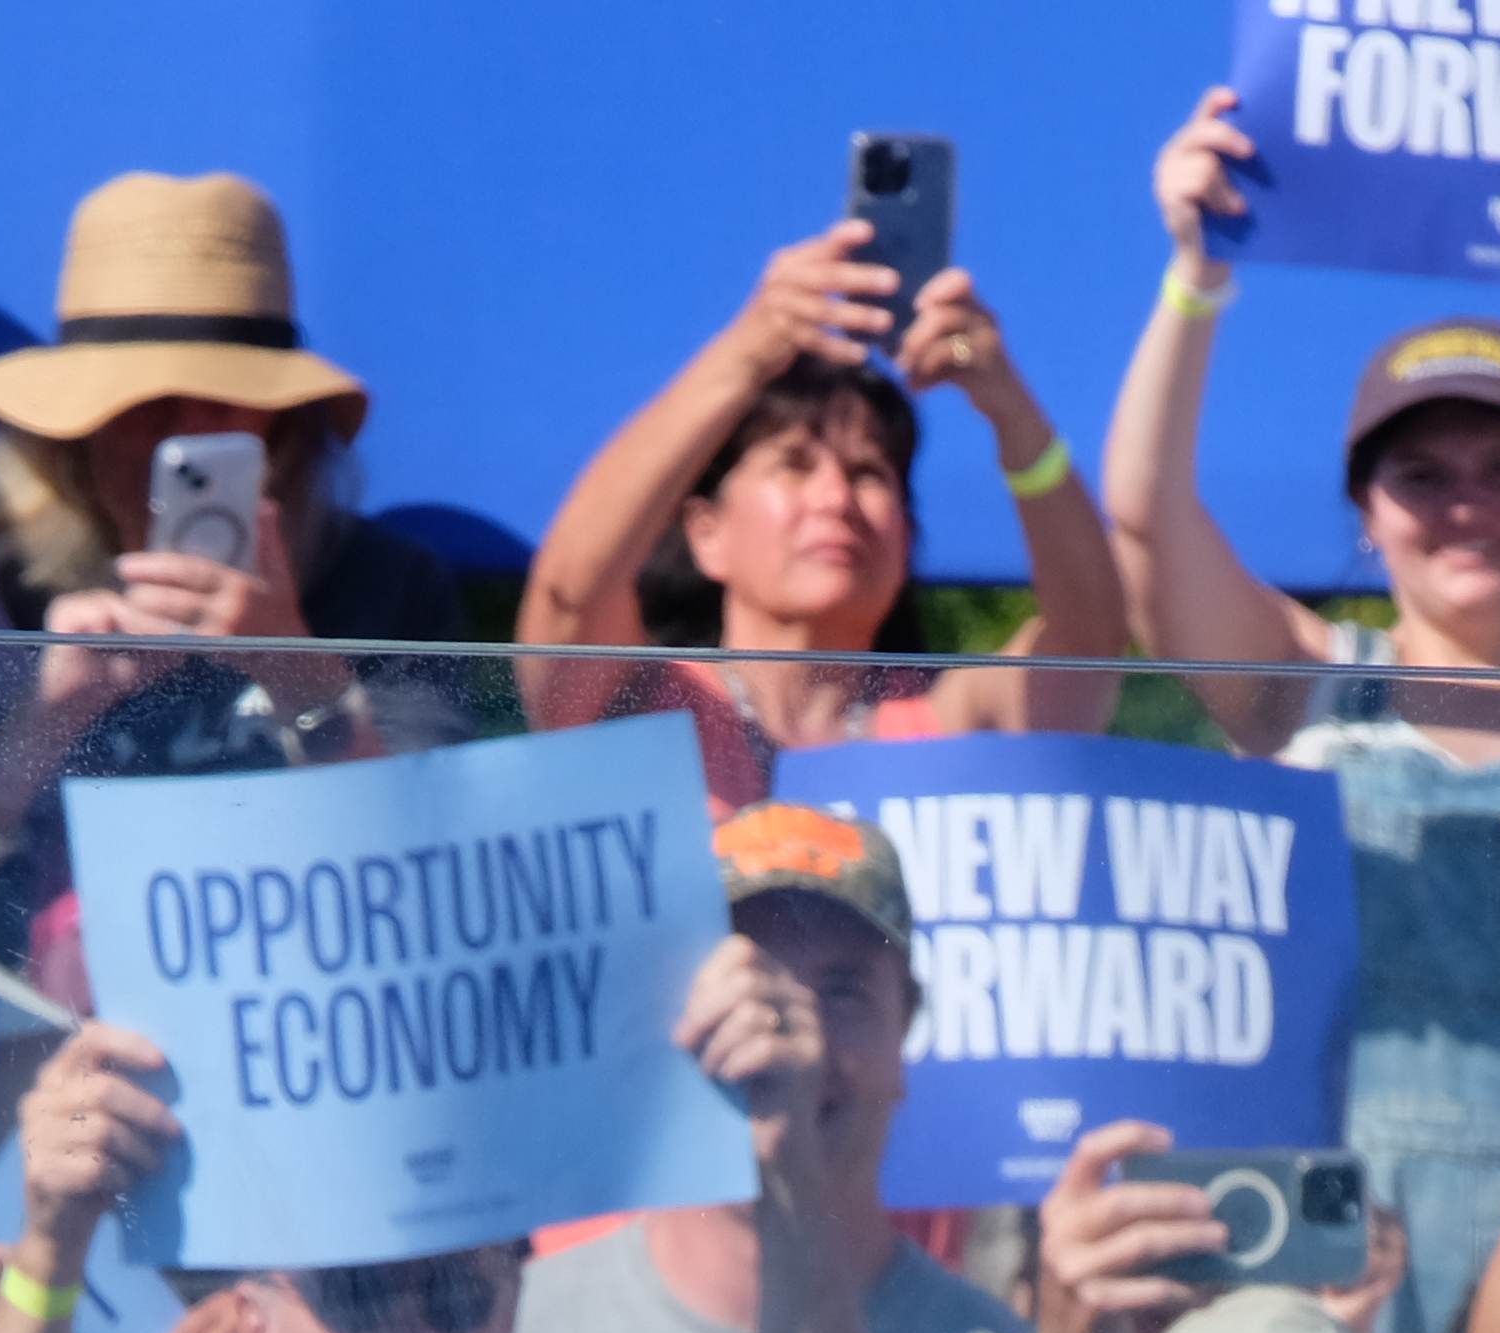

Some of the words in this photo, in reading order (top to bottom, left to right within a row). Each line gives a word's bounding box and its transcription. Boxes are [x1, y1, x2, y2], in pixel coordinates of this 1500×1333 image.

[145, 811, 662, 982] OPPORTUNITY
[879, 793, 1091, 920] NEW
[1106, 796, 1296, 935] WAY
[231, 946, 606, 1108] ECONOMY
